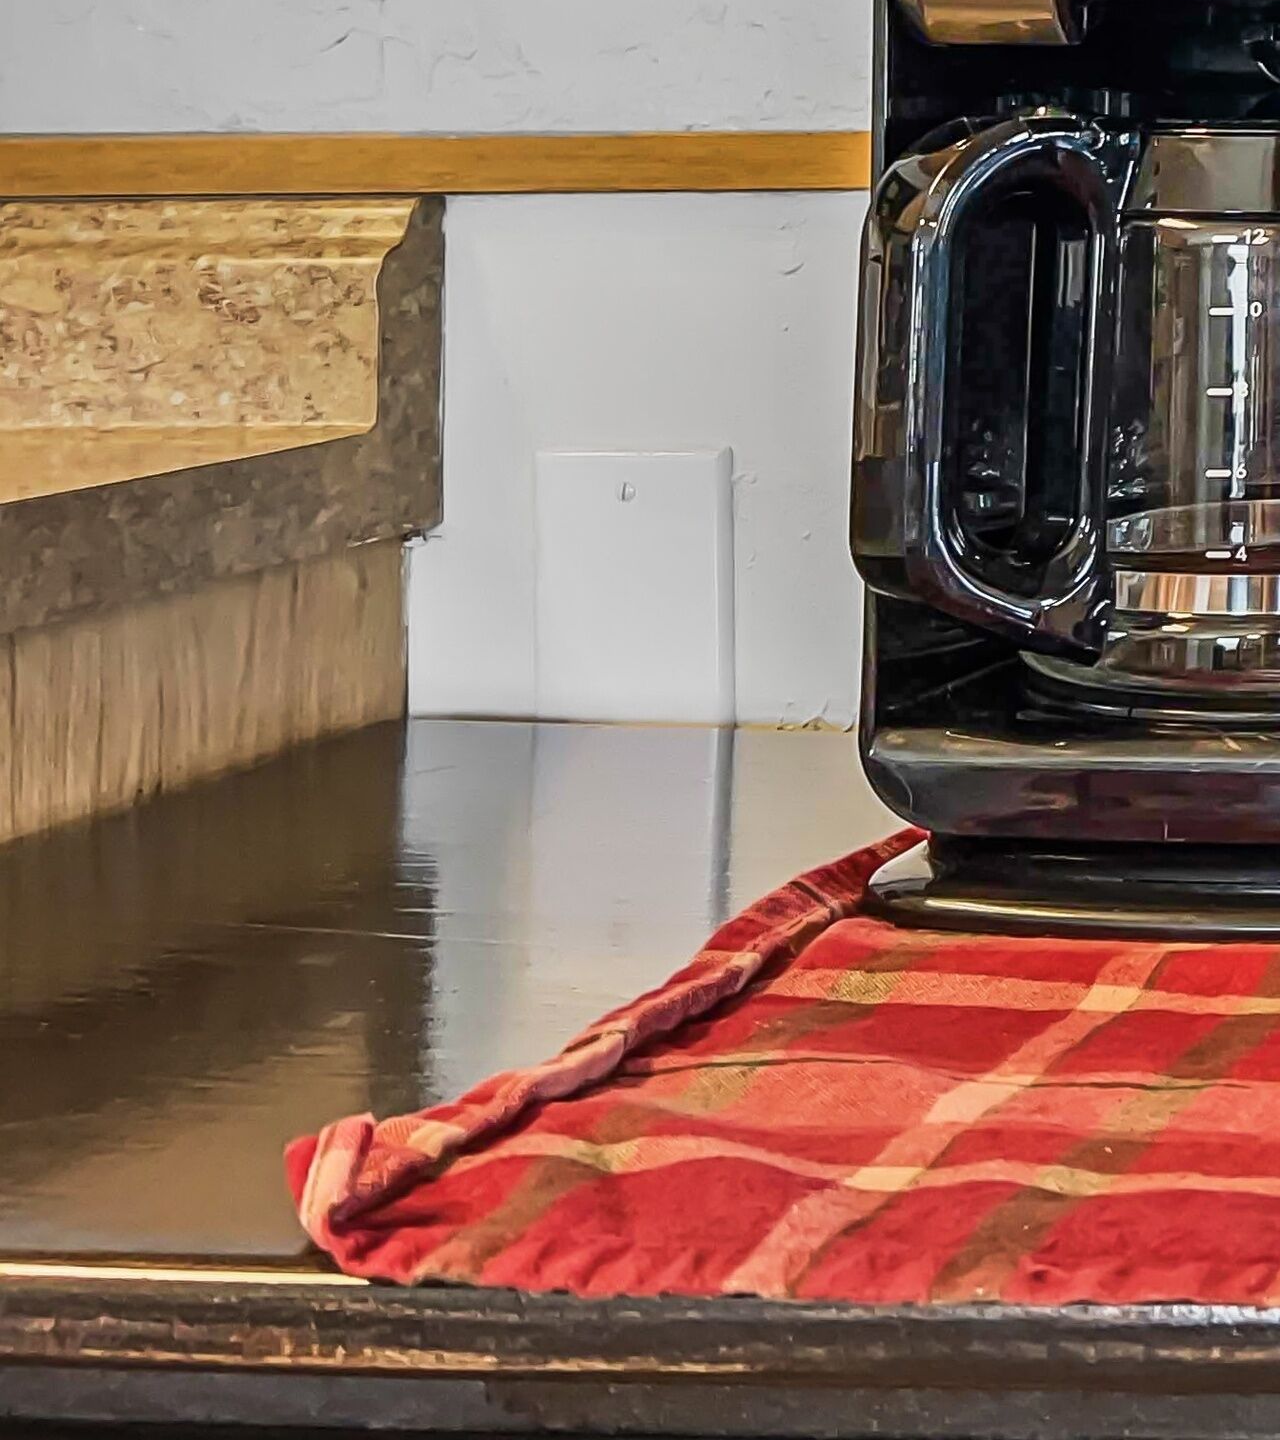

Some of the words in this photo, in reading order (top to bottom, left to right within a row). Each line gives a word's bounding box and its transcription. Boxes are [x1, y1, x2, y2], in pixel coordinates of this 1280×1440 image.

[1242, 228, 1270, 245] 12
[1234, 461, 1248, 480] 6
[1234, 544, 1248, 562] 4
